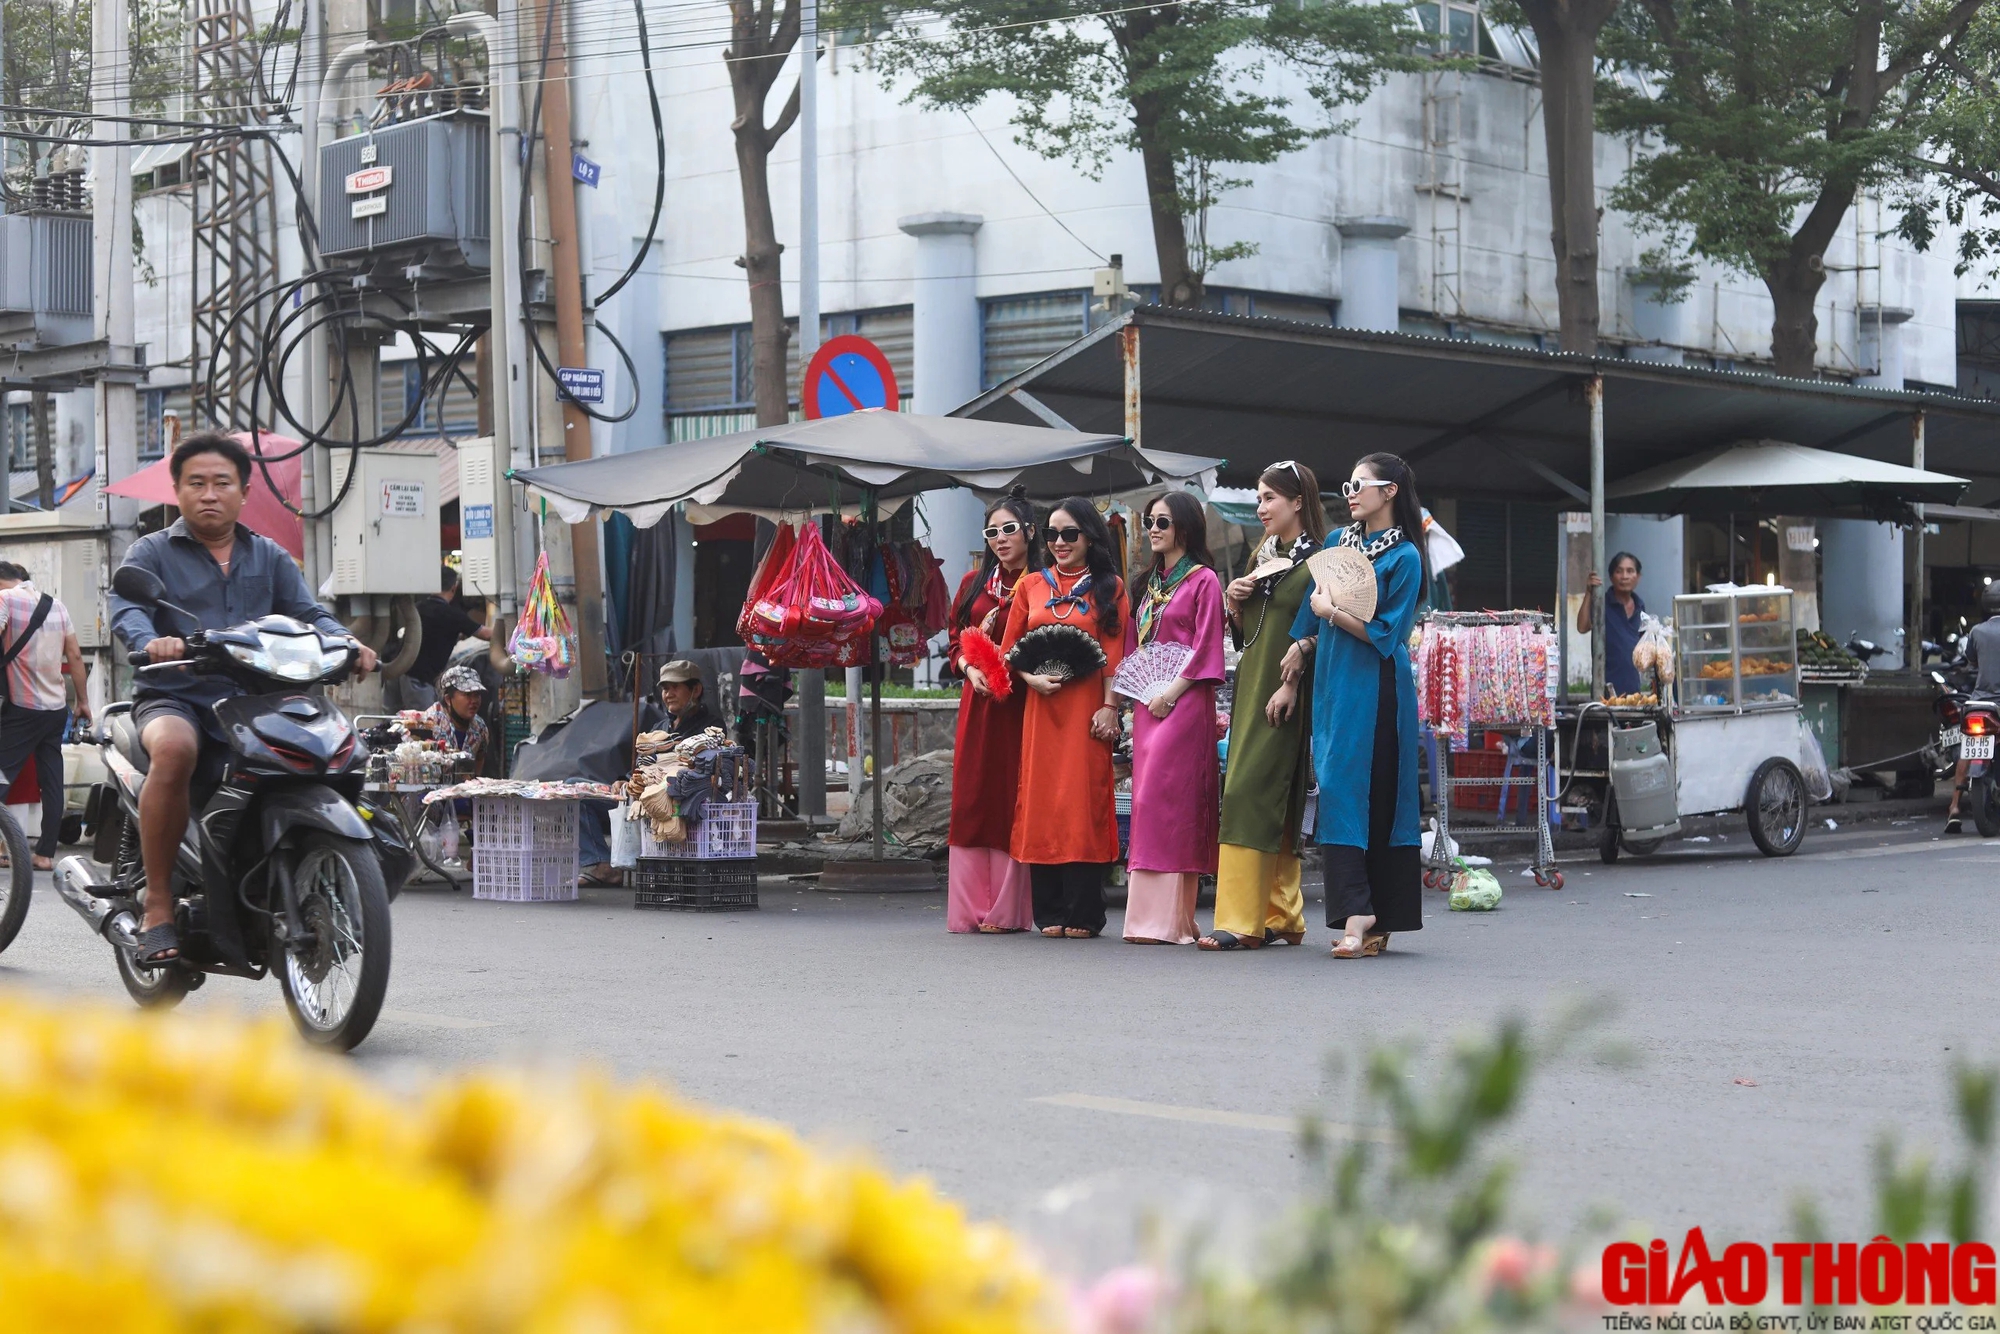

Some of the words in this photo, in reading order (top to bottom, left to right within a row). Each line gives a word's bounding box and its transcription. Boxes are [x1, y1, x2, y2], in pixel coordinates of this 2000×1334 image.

[588, 168, 594, 178] 2
[1966, 737, 1990, 747] 60-H5
[1965, 748, 1989, 758] 3939
